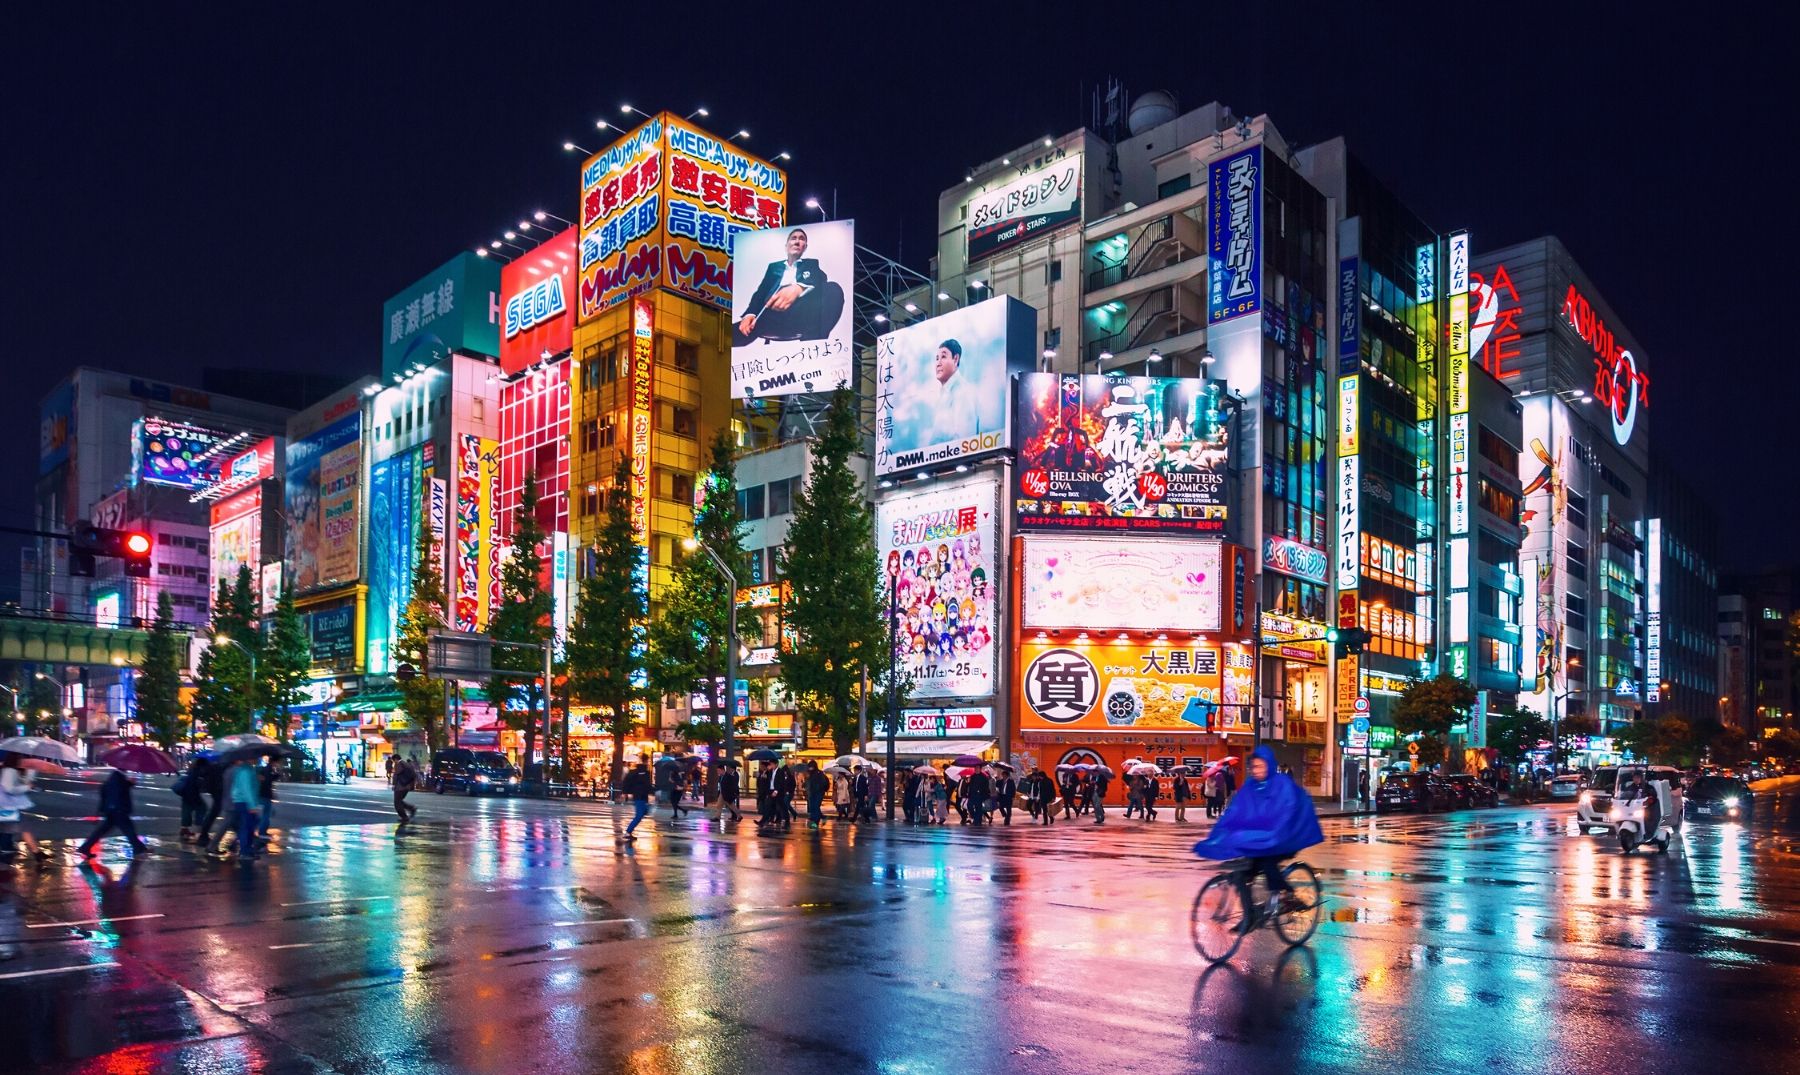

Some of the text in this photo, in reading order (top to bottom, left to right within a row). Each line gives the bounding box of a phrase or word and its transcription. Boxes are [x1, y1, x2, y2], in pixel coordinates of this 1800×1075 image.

[584, 118, 662, 190] MEDIAリサイクル
[584, 151, 661, 229] 激安販売
[669, 156, 782, 228] 激安販売
[974, 168, 1075, 228] メイドカジノ
[582, 194, 659, 270] 高額買取
[998, 216, 1047, 242] POKER STARS
[581, 244, 662, 316] Mulan
[679, 282, 715, 300] ムーラン
[506, 274, 565, 337] SEGA
[877, 336, 895, 474] 次は太陽か。
[961, 431, 1001, 454] solar
[1050, 471, 1103, 482] HELLSING
[1167, 472, 1223, 484] DRIFTERS
[1050, 481, 1218, 493] OVA COMICS 6
[432, 481, 443, 525] AKKY
[1264, 537, 1327, 579] メイドカジノ
[1104, 650, 1217, 675] チケット 大黒屋
[1034, 660, 1092, 715] 質
[1357, 701, 1366, 709] 40
[908, 715, 967, 729] COM ZIN
[1146, 745, 1186, 754] チケット
